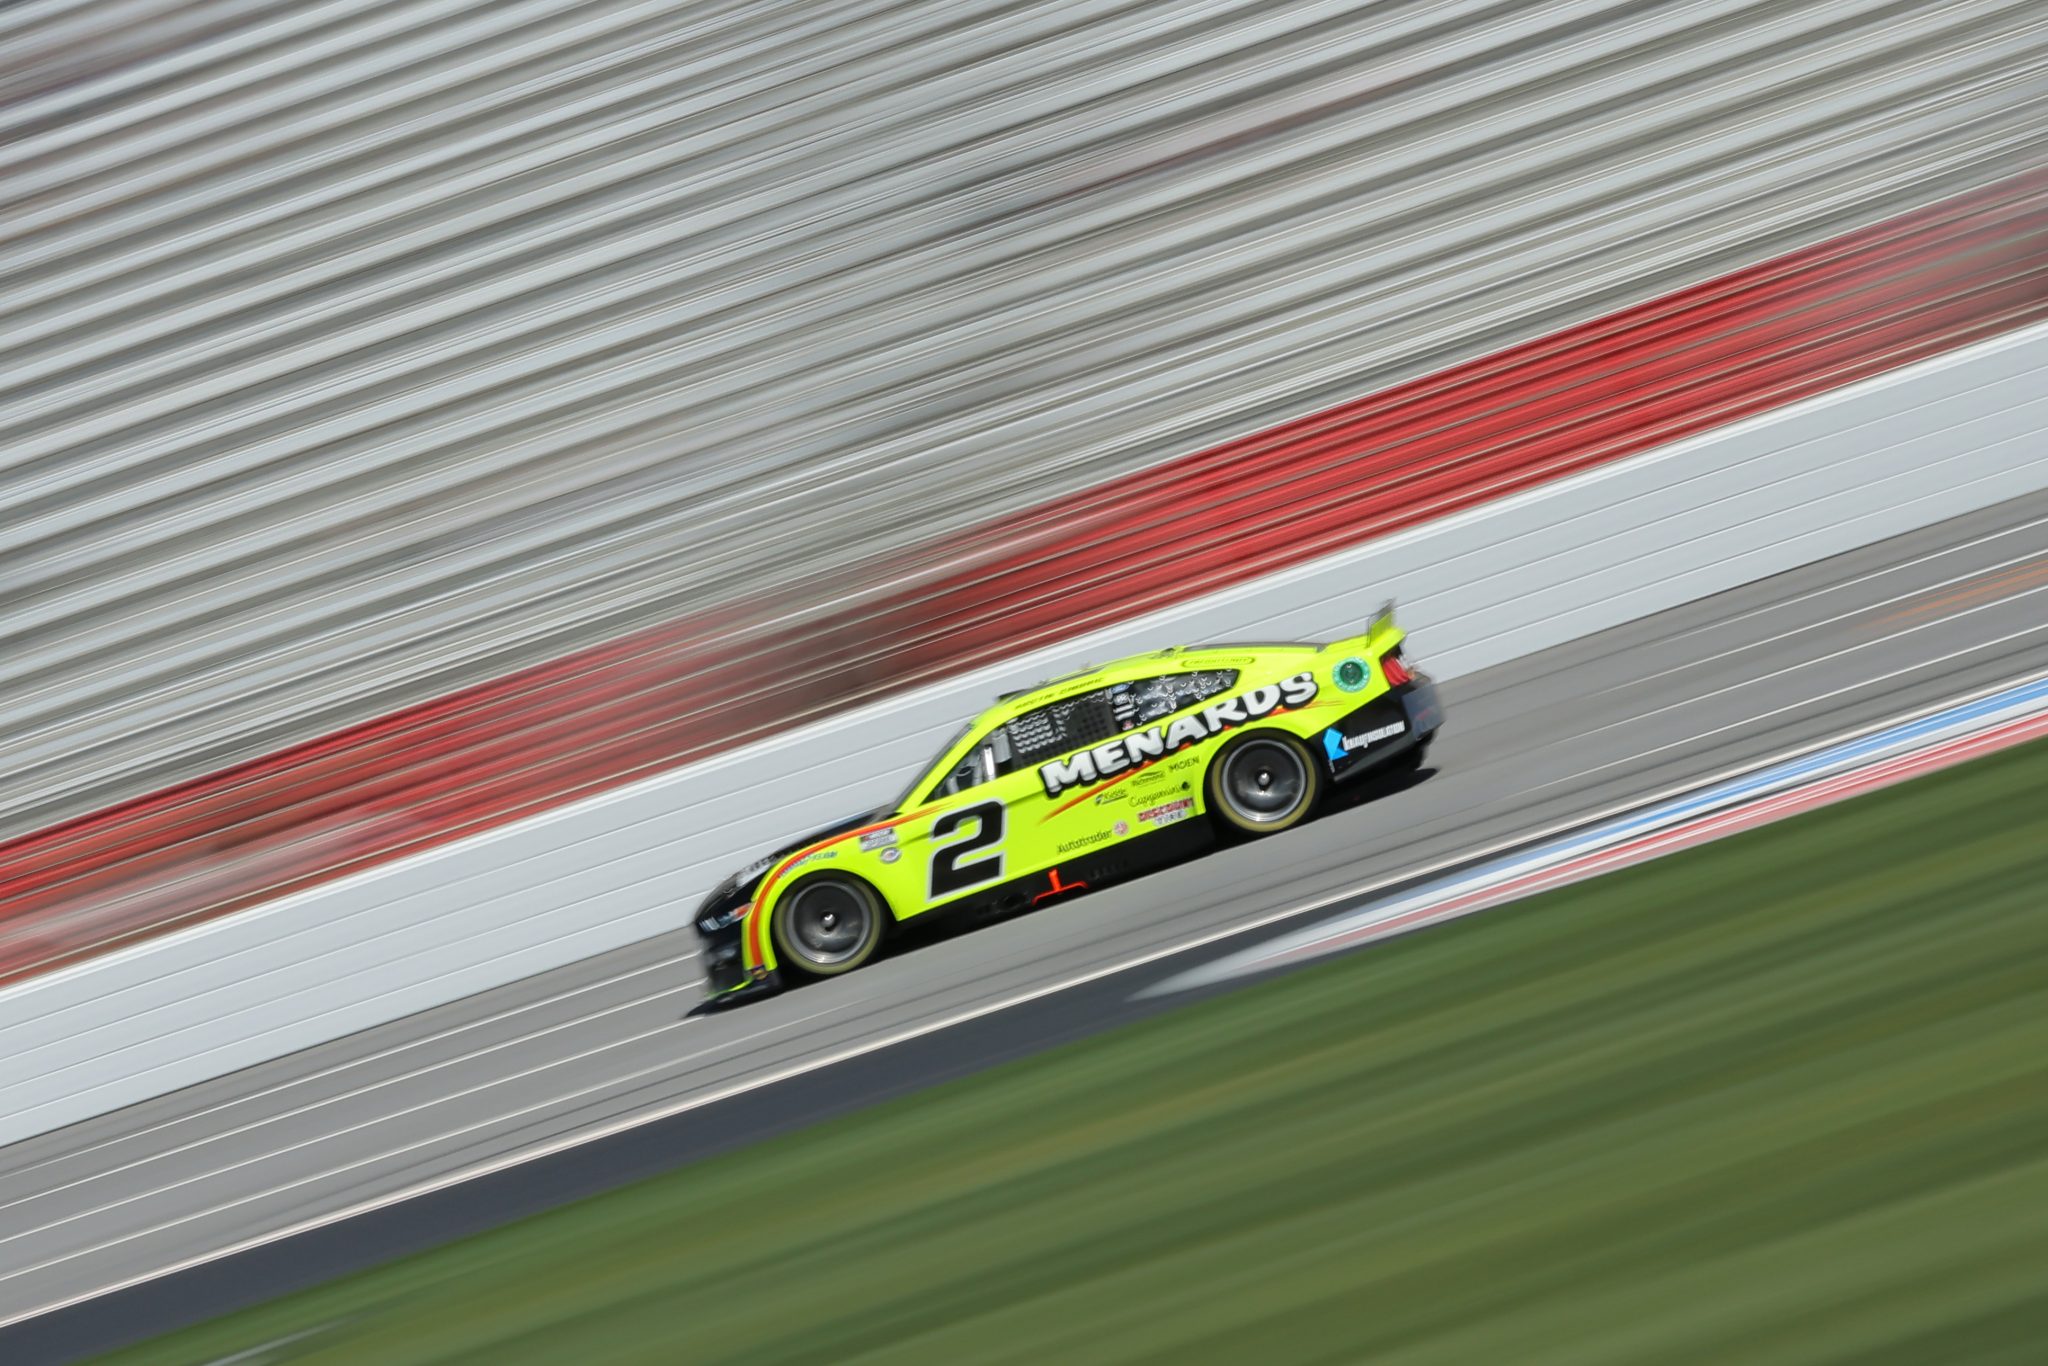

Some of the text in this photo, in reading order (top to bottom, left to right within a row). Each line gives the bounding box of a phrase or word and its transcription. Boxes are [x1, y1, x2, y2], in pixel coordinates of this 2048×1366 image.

[1039, 671, 1319, 797] MENARDS
[1168, 755, 1200, 773] MOEN
[926, 798, 1008, 903] 2
